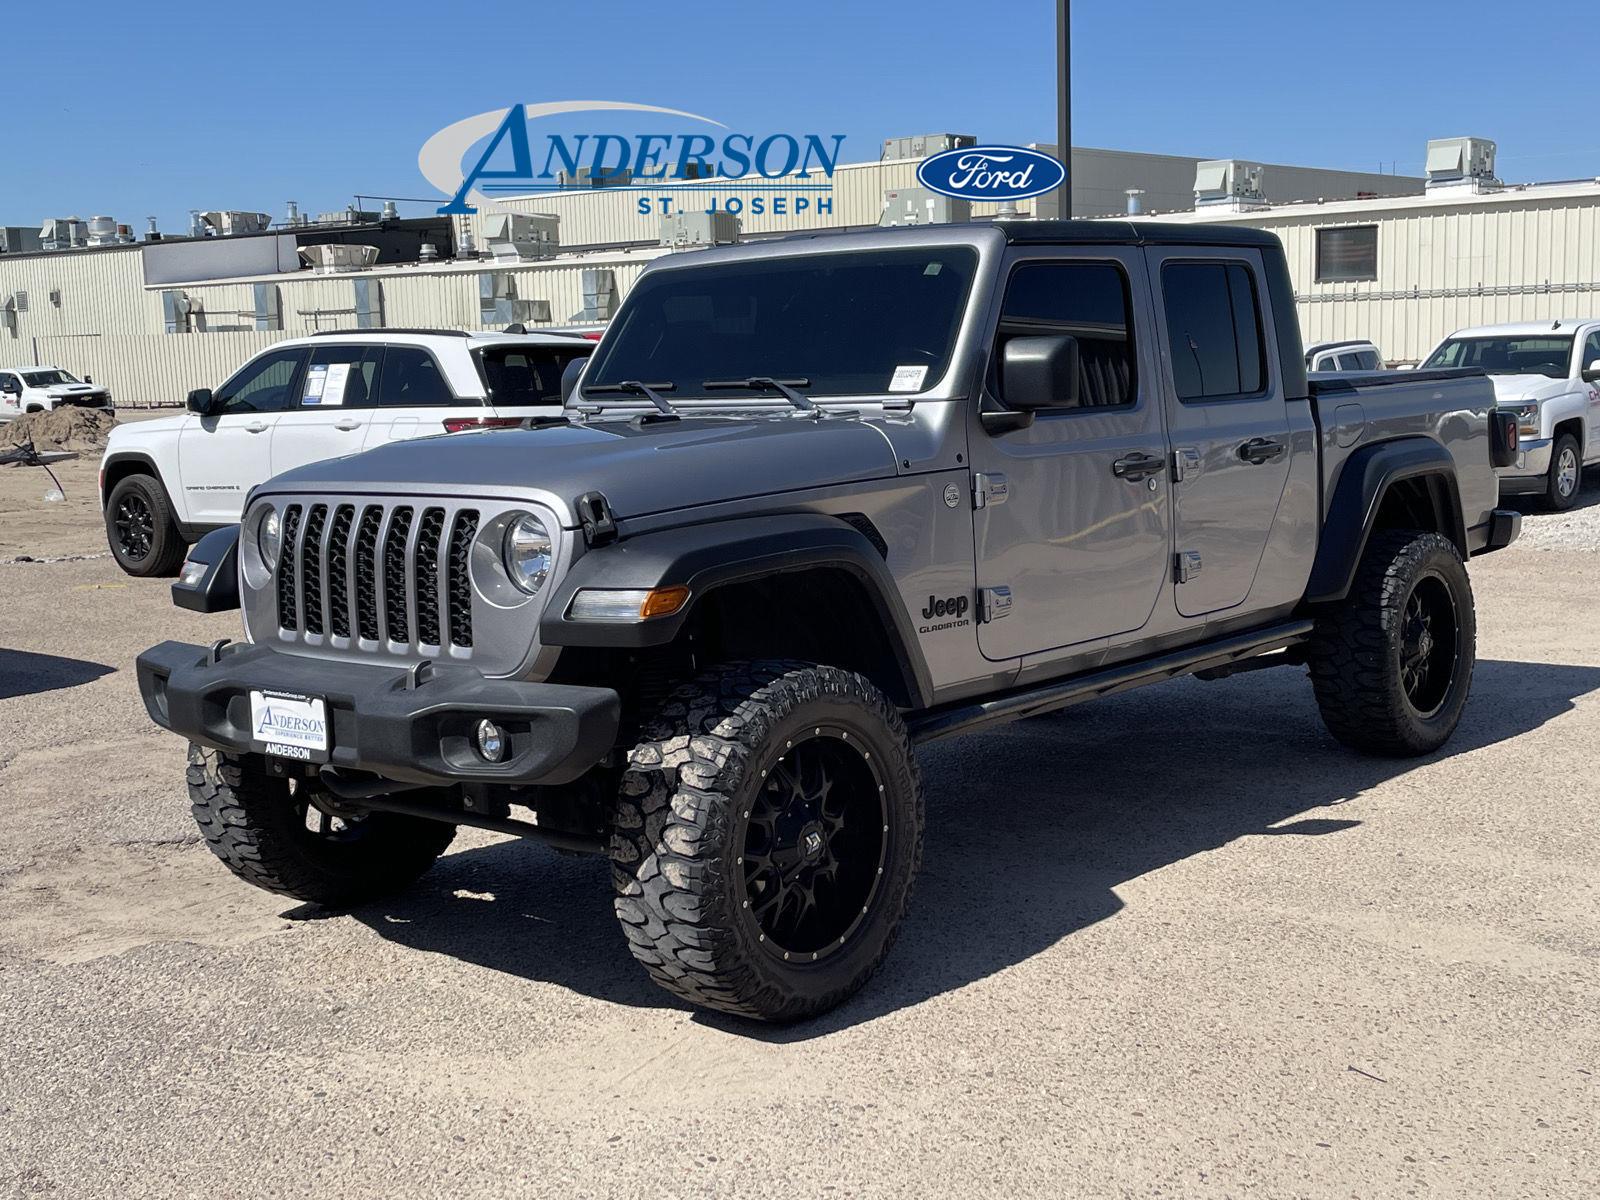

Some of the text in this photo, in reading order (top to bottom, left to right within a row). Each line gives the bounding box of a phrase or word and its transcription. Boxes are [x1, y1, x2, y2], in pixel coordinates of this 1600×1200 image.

[922, 595, 969, 619] Jeep
[919, 619, 969, 634] GLADIATOR
[257, 705, 324, 734] ANDERSON
[265, 742, 310, 759] ANDERSON
